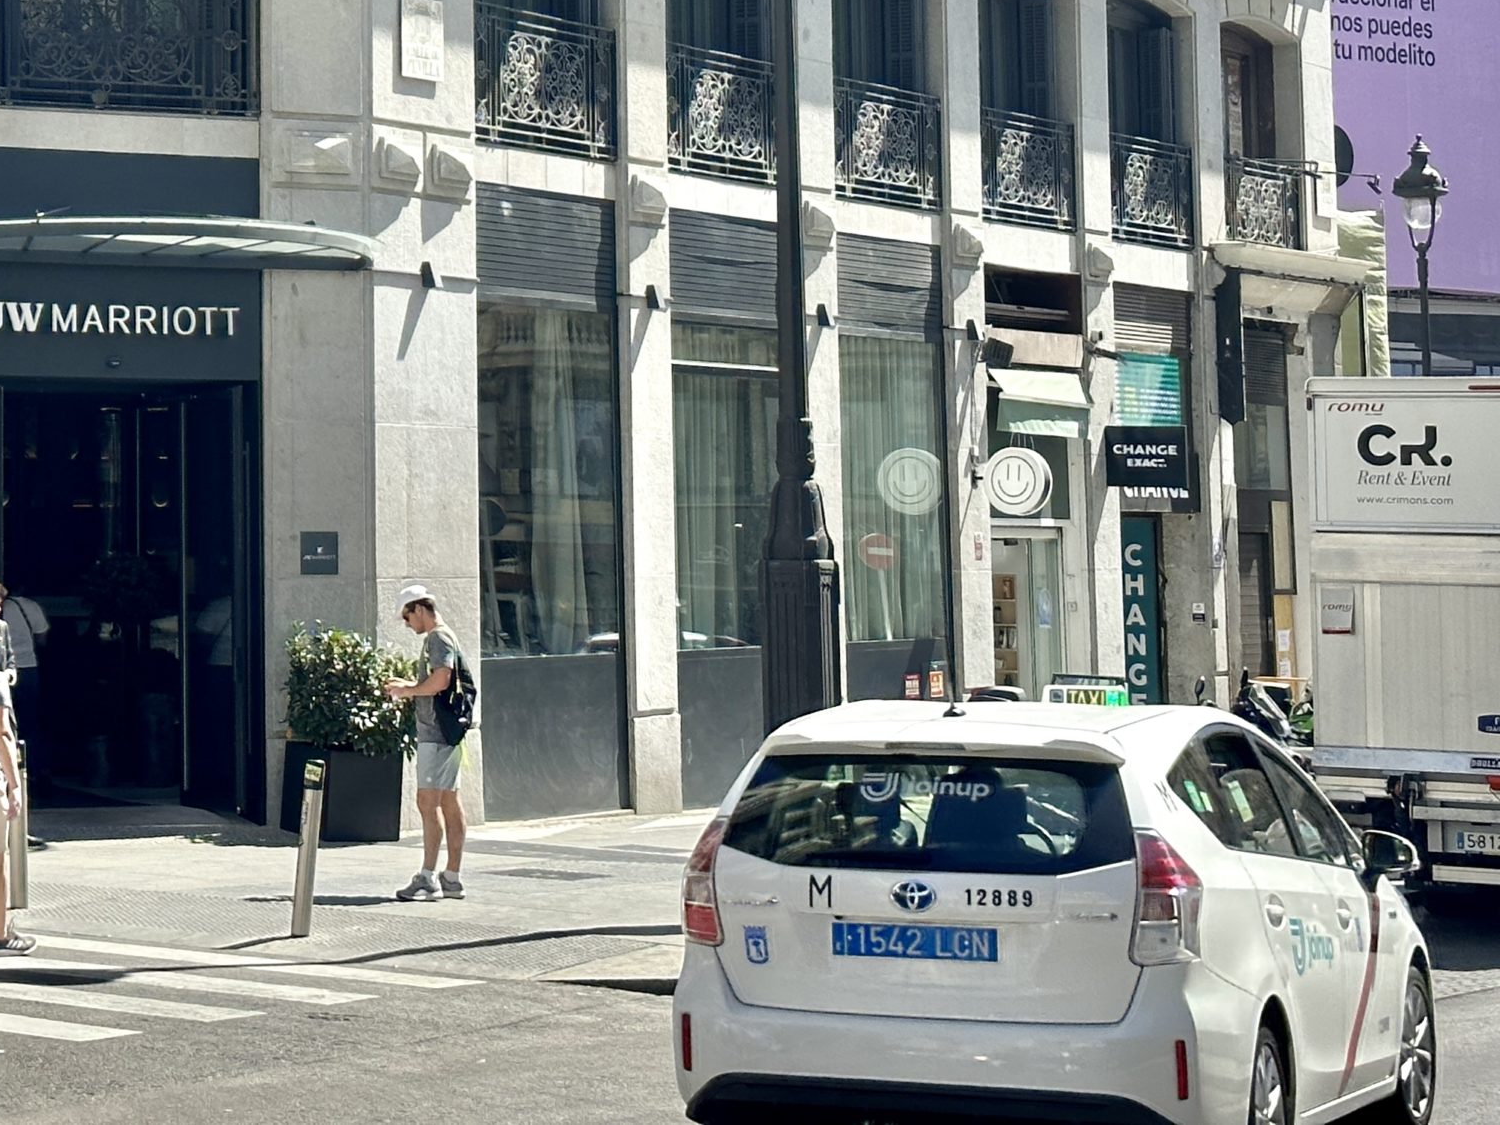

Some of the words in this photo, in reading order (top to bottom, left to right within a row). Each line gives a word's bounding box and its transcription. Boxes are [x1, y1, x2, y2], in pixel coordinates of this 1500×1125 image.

[1368, 15, 1433, 39] puedes
[1333, 39, 1352, 60] tu
[1358, 41, 1436, 67] modelito
[51, 304, 240, 336] MARRIOTT
[1328, 402, 1384, 412] romu
[1112, 444, 1178, 455] CHANGE
[1357, 470, 1391, 485] Rent
[1394, 472, 1407, 485] &
[1411, 471, 1452, 486] Event
[1068, 690, 1105, 704] TAXI
[809, 875, 832, 907] M
[965, 888, 1033, 907] 12889
[857, 926, 924, 957] 1542
[935, 930, 991, 959] LCN
